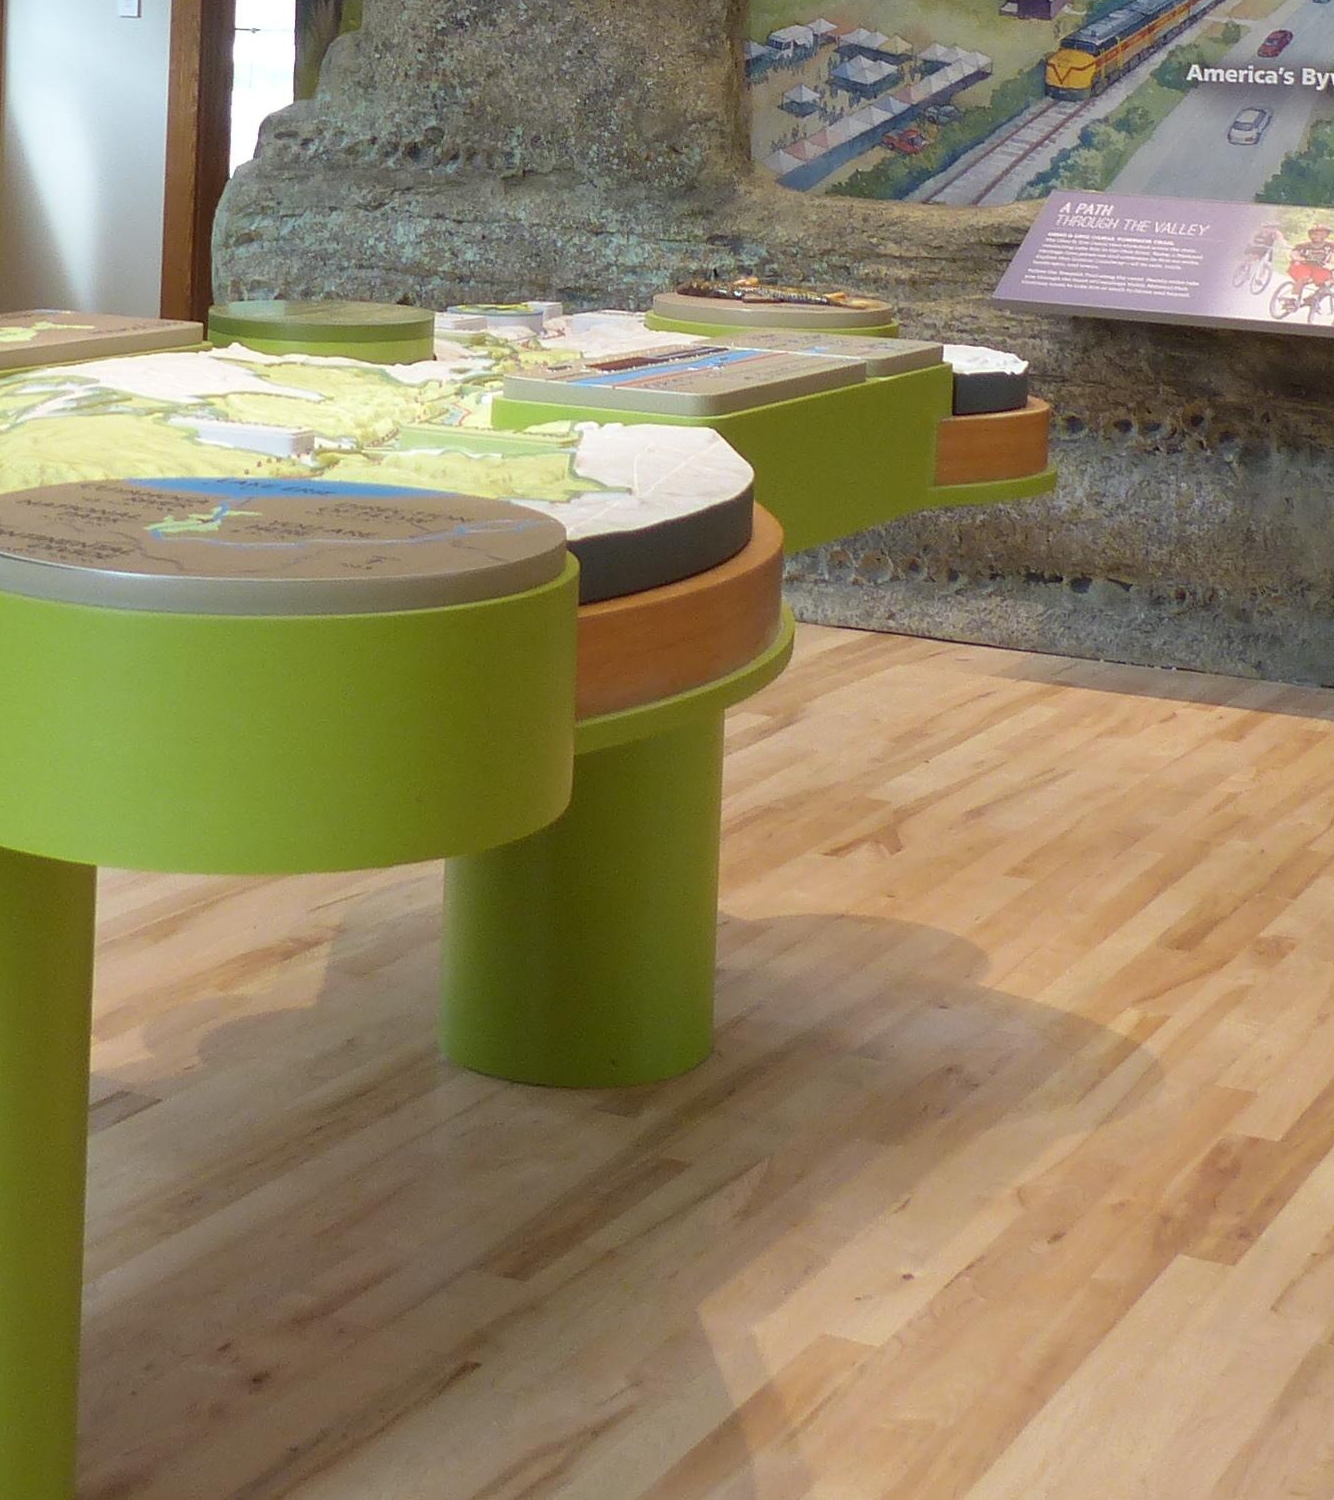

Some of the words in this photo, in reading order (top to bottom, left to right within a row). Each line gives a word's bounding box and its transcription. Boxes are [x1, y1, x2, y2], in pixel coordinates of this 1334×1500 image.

[1060, 202, 1072, 214] A
[1075, 203, 1114, 215] PATH
[1055, 214, 1119, 230] THROUGH
[1123, 219, 1151, 233] THE
[1154, 221, 1210, 237] VALLEY
